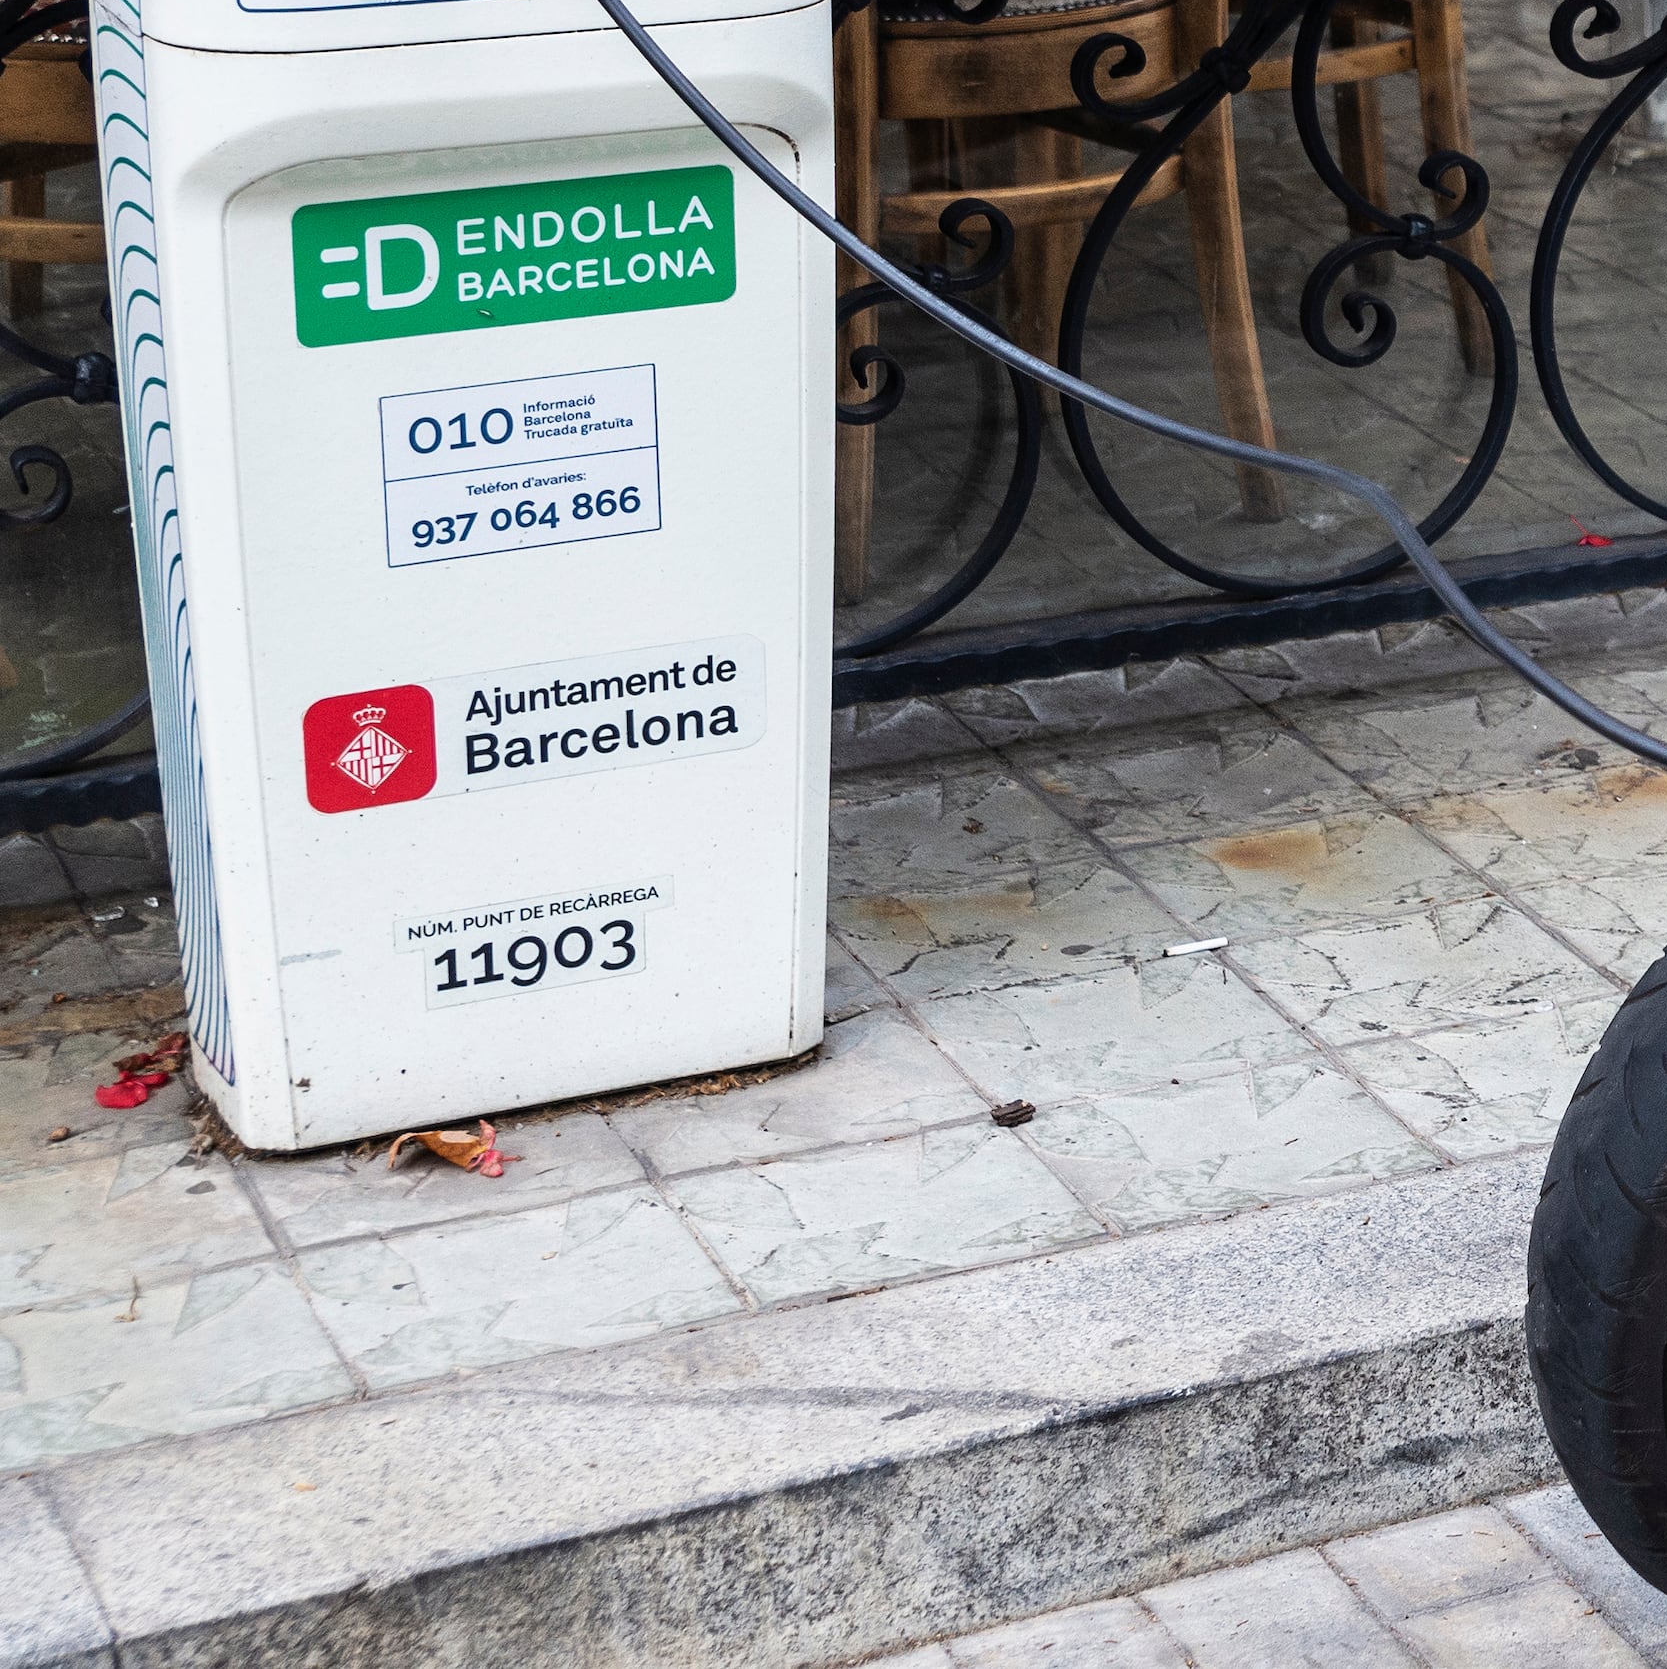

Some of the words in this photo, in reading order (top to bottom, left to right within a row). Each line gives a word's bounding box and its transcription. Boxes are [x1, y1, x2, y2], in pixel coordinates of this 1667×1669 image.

[456, 195, 714, 256] ENDOLLA
[457, 246, 716, 302] BARCELONA
[408, 406, 514, 455] 010
[523, 394, 596, 413] Informació
[524, 407, 592, 427] Barcelona
[524, 423, 578, 441] Trucada
[581, 416, 634, 435] gratuïta
[466, 478, 519, 497] Telèfon
[522, 472, 587, 489] d'avaries:
[412, 512, 479, 548] 937
[490, 500, 561, 532] 064
[572, 486, 641, 521] 866
[465, 660, 686, 727] Ajuntament
[692, 654, 737, 685] de
[465, 703, 739, 775] Barcelona
[408, 919, 459, 941] NÚM.
[463, 909, 516, 930] PUNT
[520, 904, 545, 922] DE
[549, 886, 660, 917] RECÀRREGA
[434, 918, 637, 993] 11903
